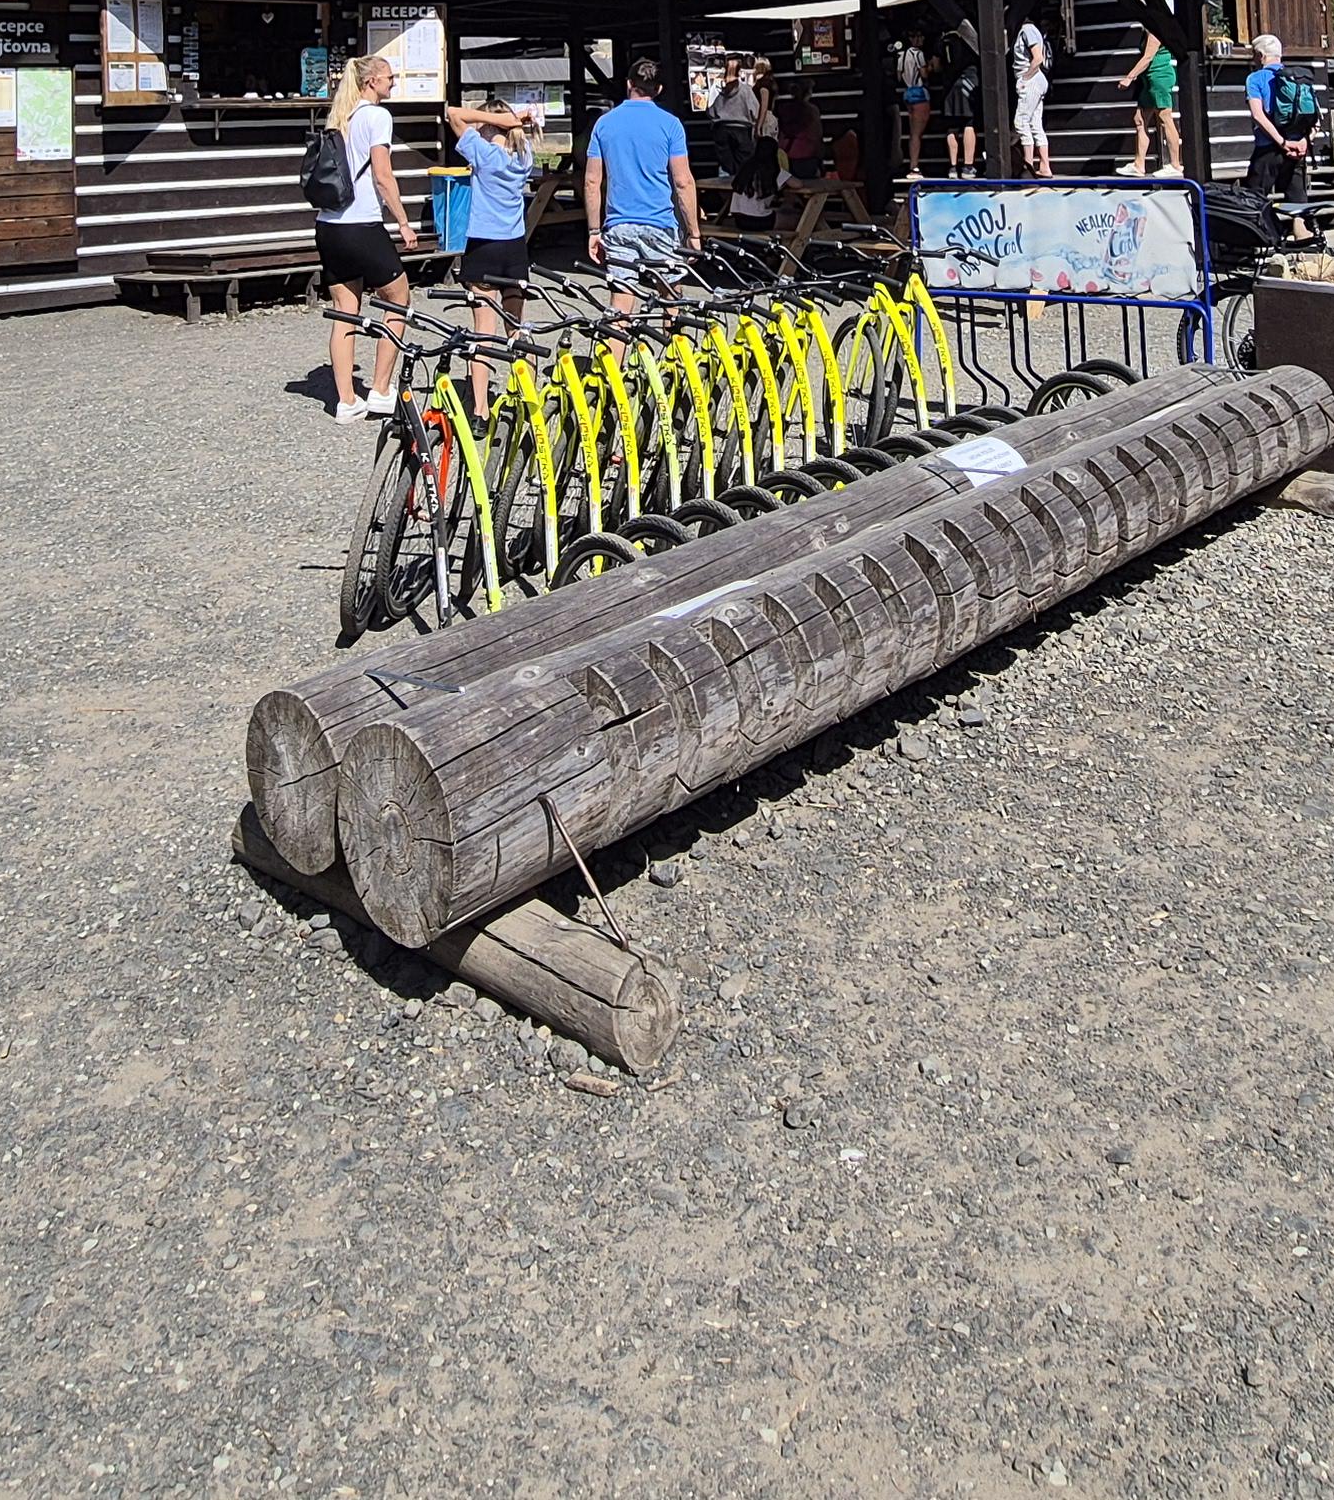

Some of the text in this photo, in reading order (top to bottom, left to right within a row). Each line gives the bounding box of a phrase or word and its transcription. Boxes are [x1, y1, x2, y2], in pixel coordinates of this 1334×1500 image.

[371, 6, 436, 18] RECEPCE
[945, 203, 1012, 249] STOOJ.
[994, 221, 1024, 259] Cool
[1075, 212, 1115, 237] NEALKO
